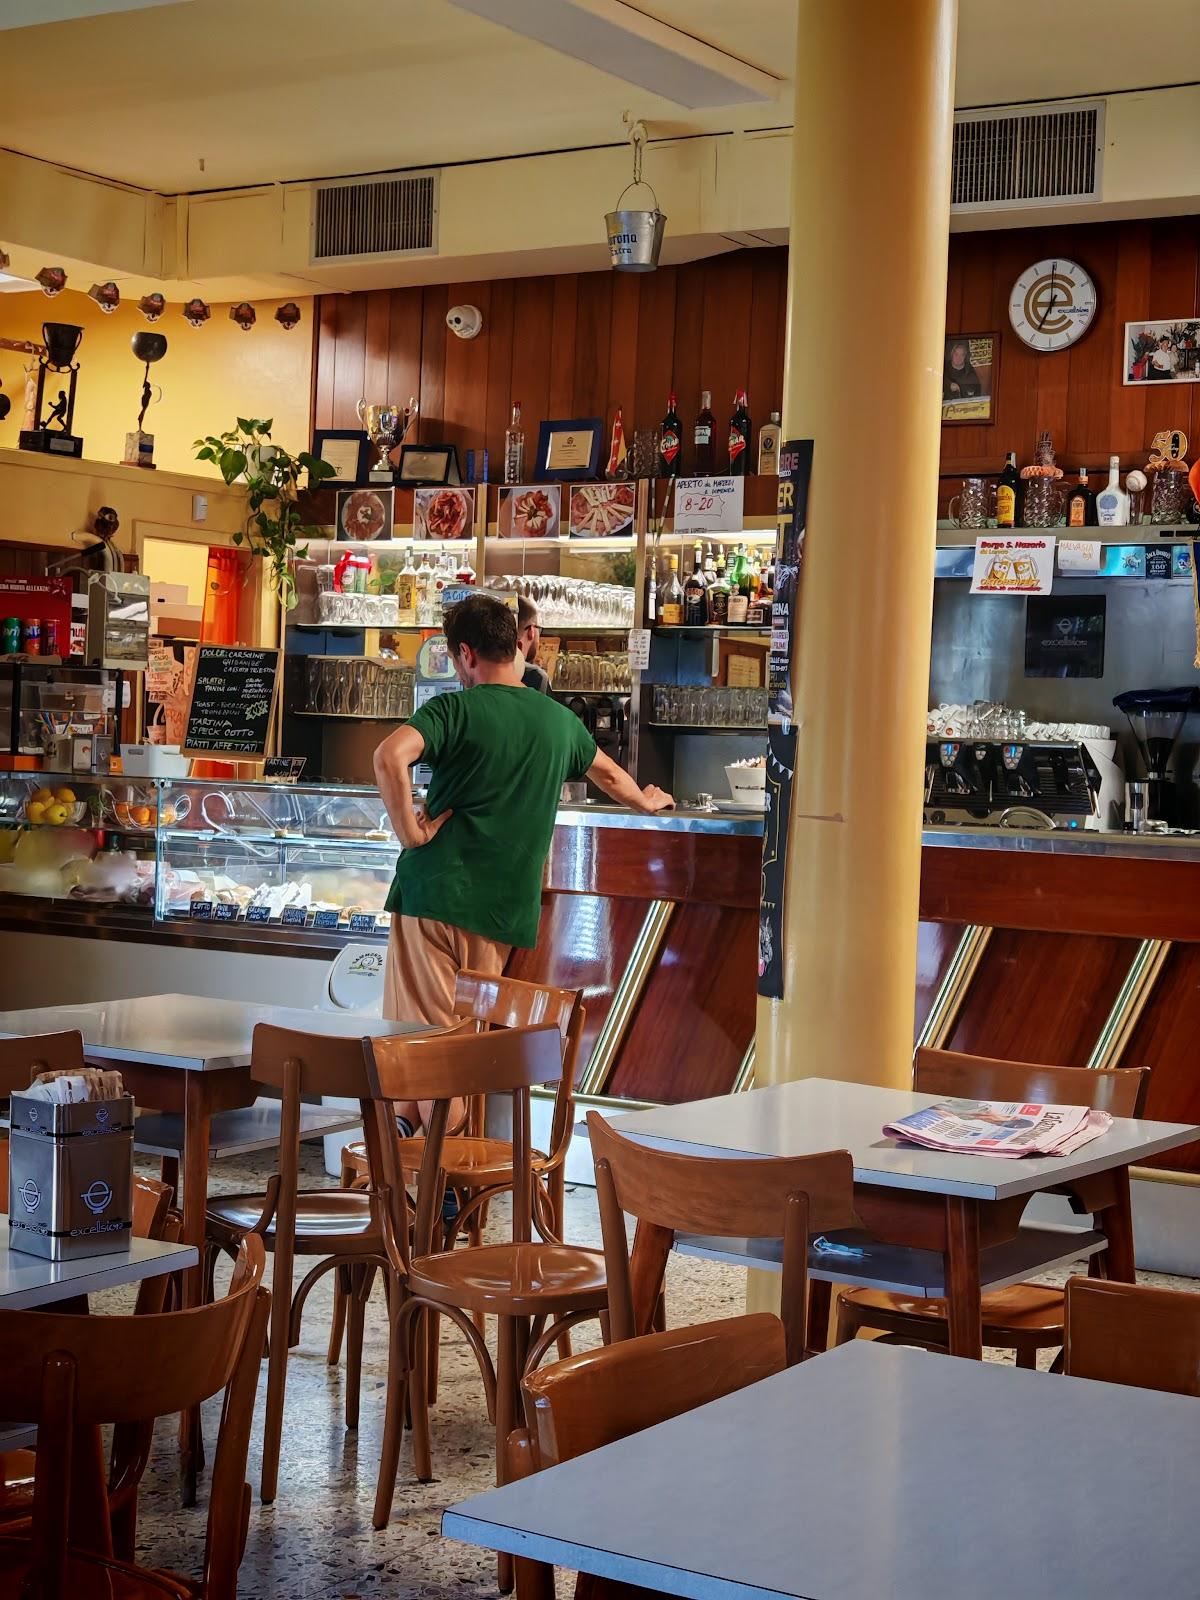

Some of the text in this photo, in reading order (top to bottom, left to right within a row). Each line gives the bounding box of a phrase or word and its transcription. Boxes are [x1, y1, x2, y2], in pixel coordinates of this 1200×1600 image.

[677, 480, 704, 489] APERTO
[684, 497, 714, 511] 8-20
[981, 541, 1005, 550] Borgo
[1006, 541, 1013, 549] S.
[190, 726, 254, 737] SPECK COTTO
[186, 738, 210, 749] PIATTI
